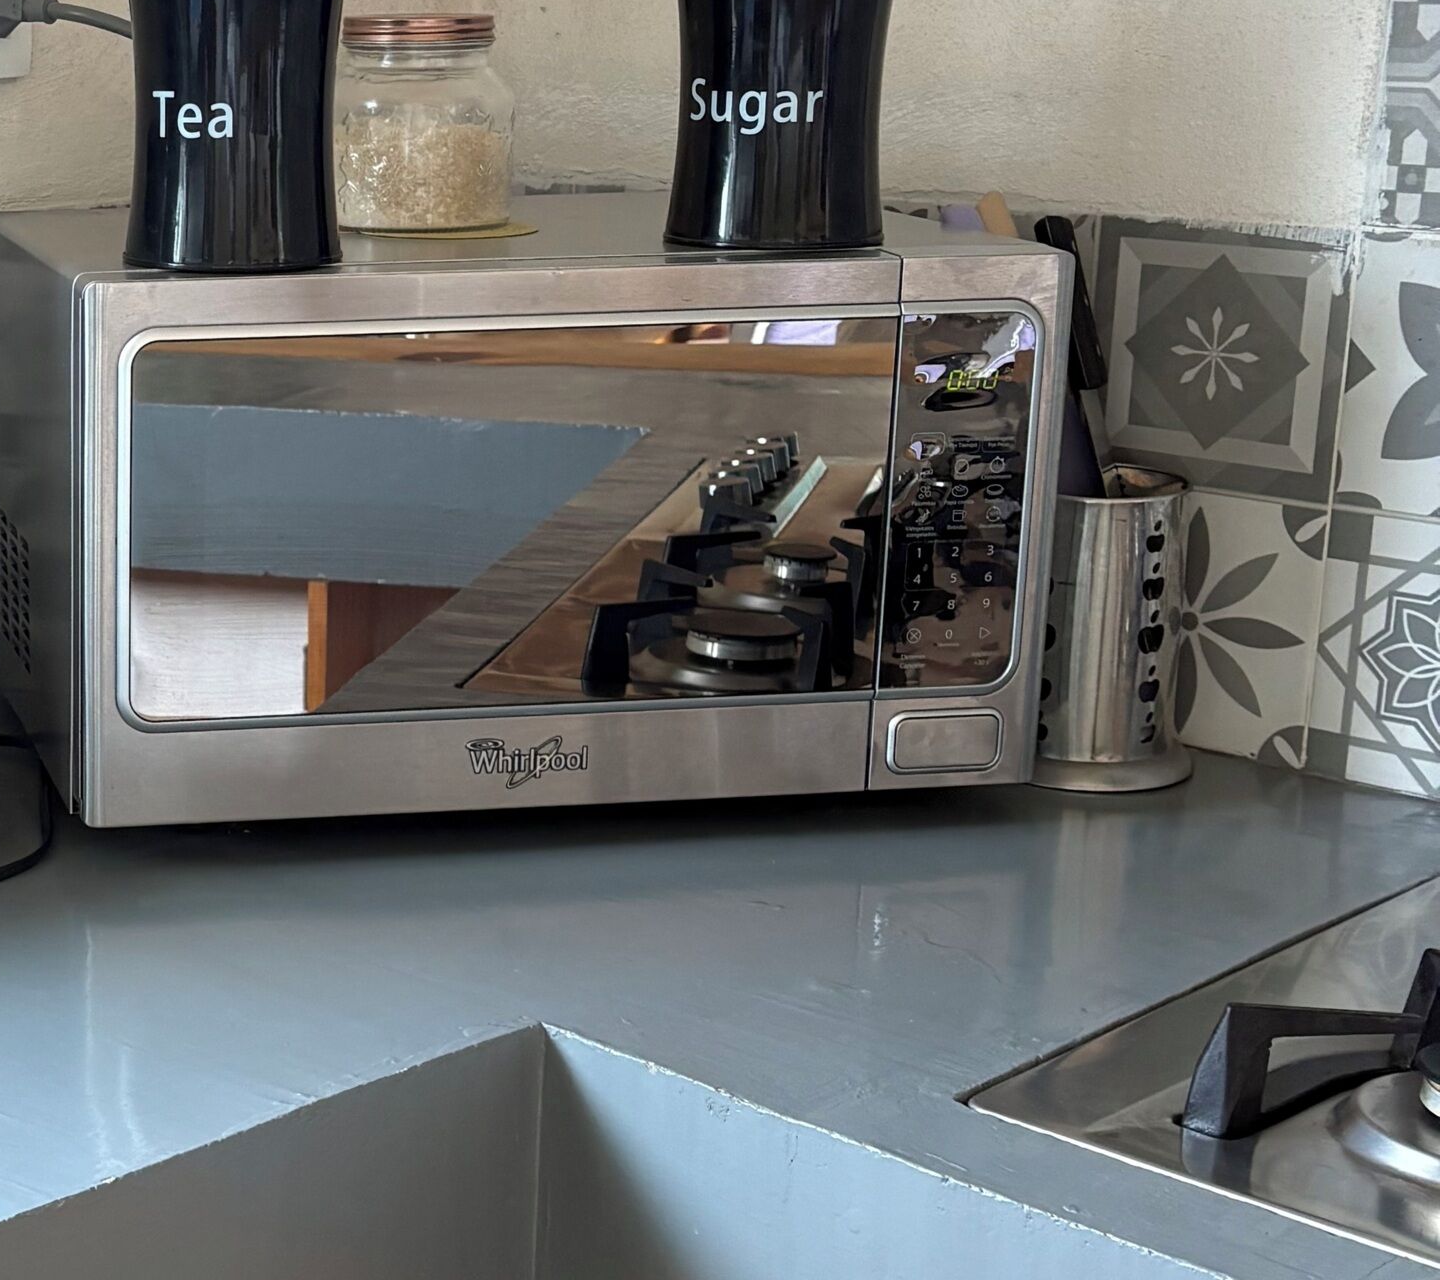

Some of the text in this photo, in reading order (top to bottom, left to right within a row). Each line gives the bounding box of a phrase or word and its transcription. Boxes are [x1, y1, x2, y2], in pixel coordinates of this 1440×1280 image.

[689, 77, 824, 135] Sugar
[152, 90, 234, 139] Tea
[916, 547, 922, 558] 1
[951, 546, 959, 557] 2
[987, 545, 994, 556] 3
[913, 574, 920, 584] 4
[950, 575, 957, 583] 5
[984, 571, 993, 582] 6
[912, 600, 920, 611] 7
[947, 600, 955, 609] 8
[983, 598, 990, 608] 9
[945, 629, 952, 639] 0
[467, 740, 588, 783] Whirlpool
